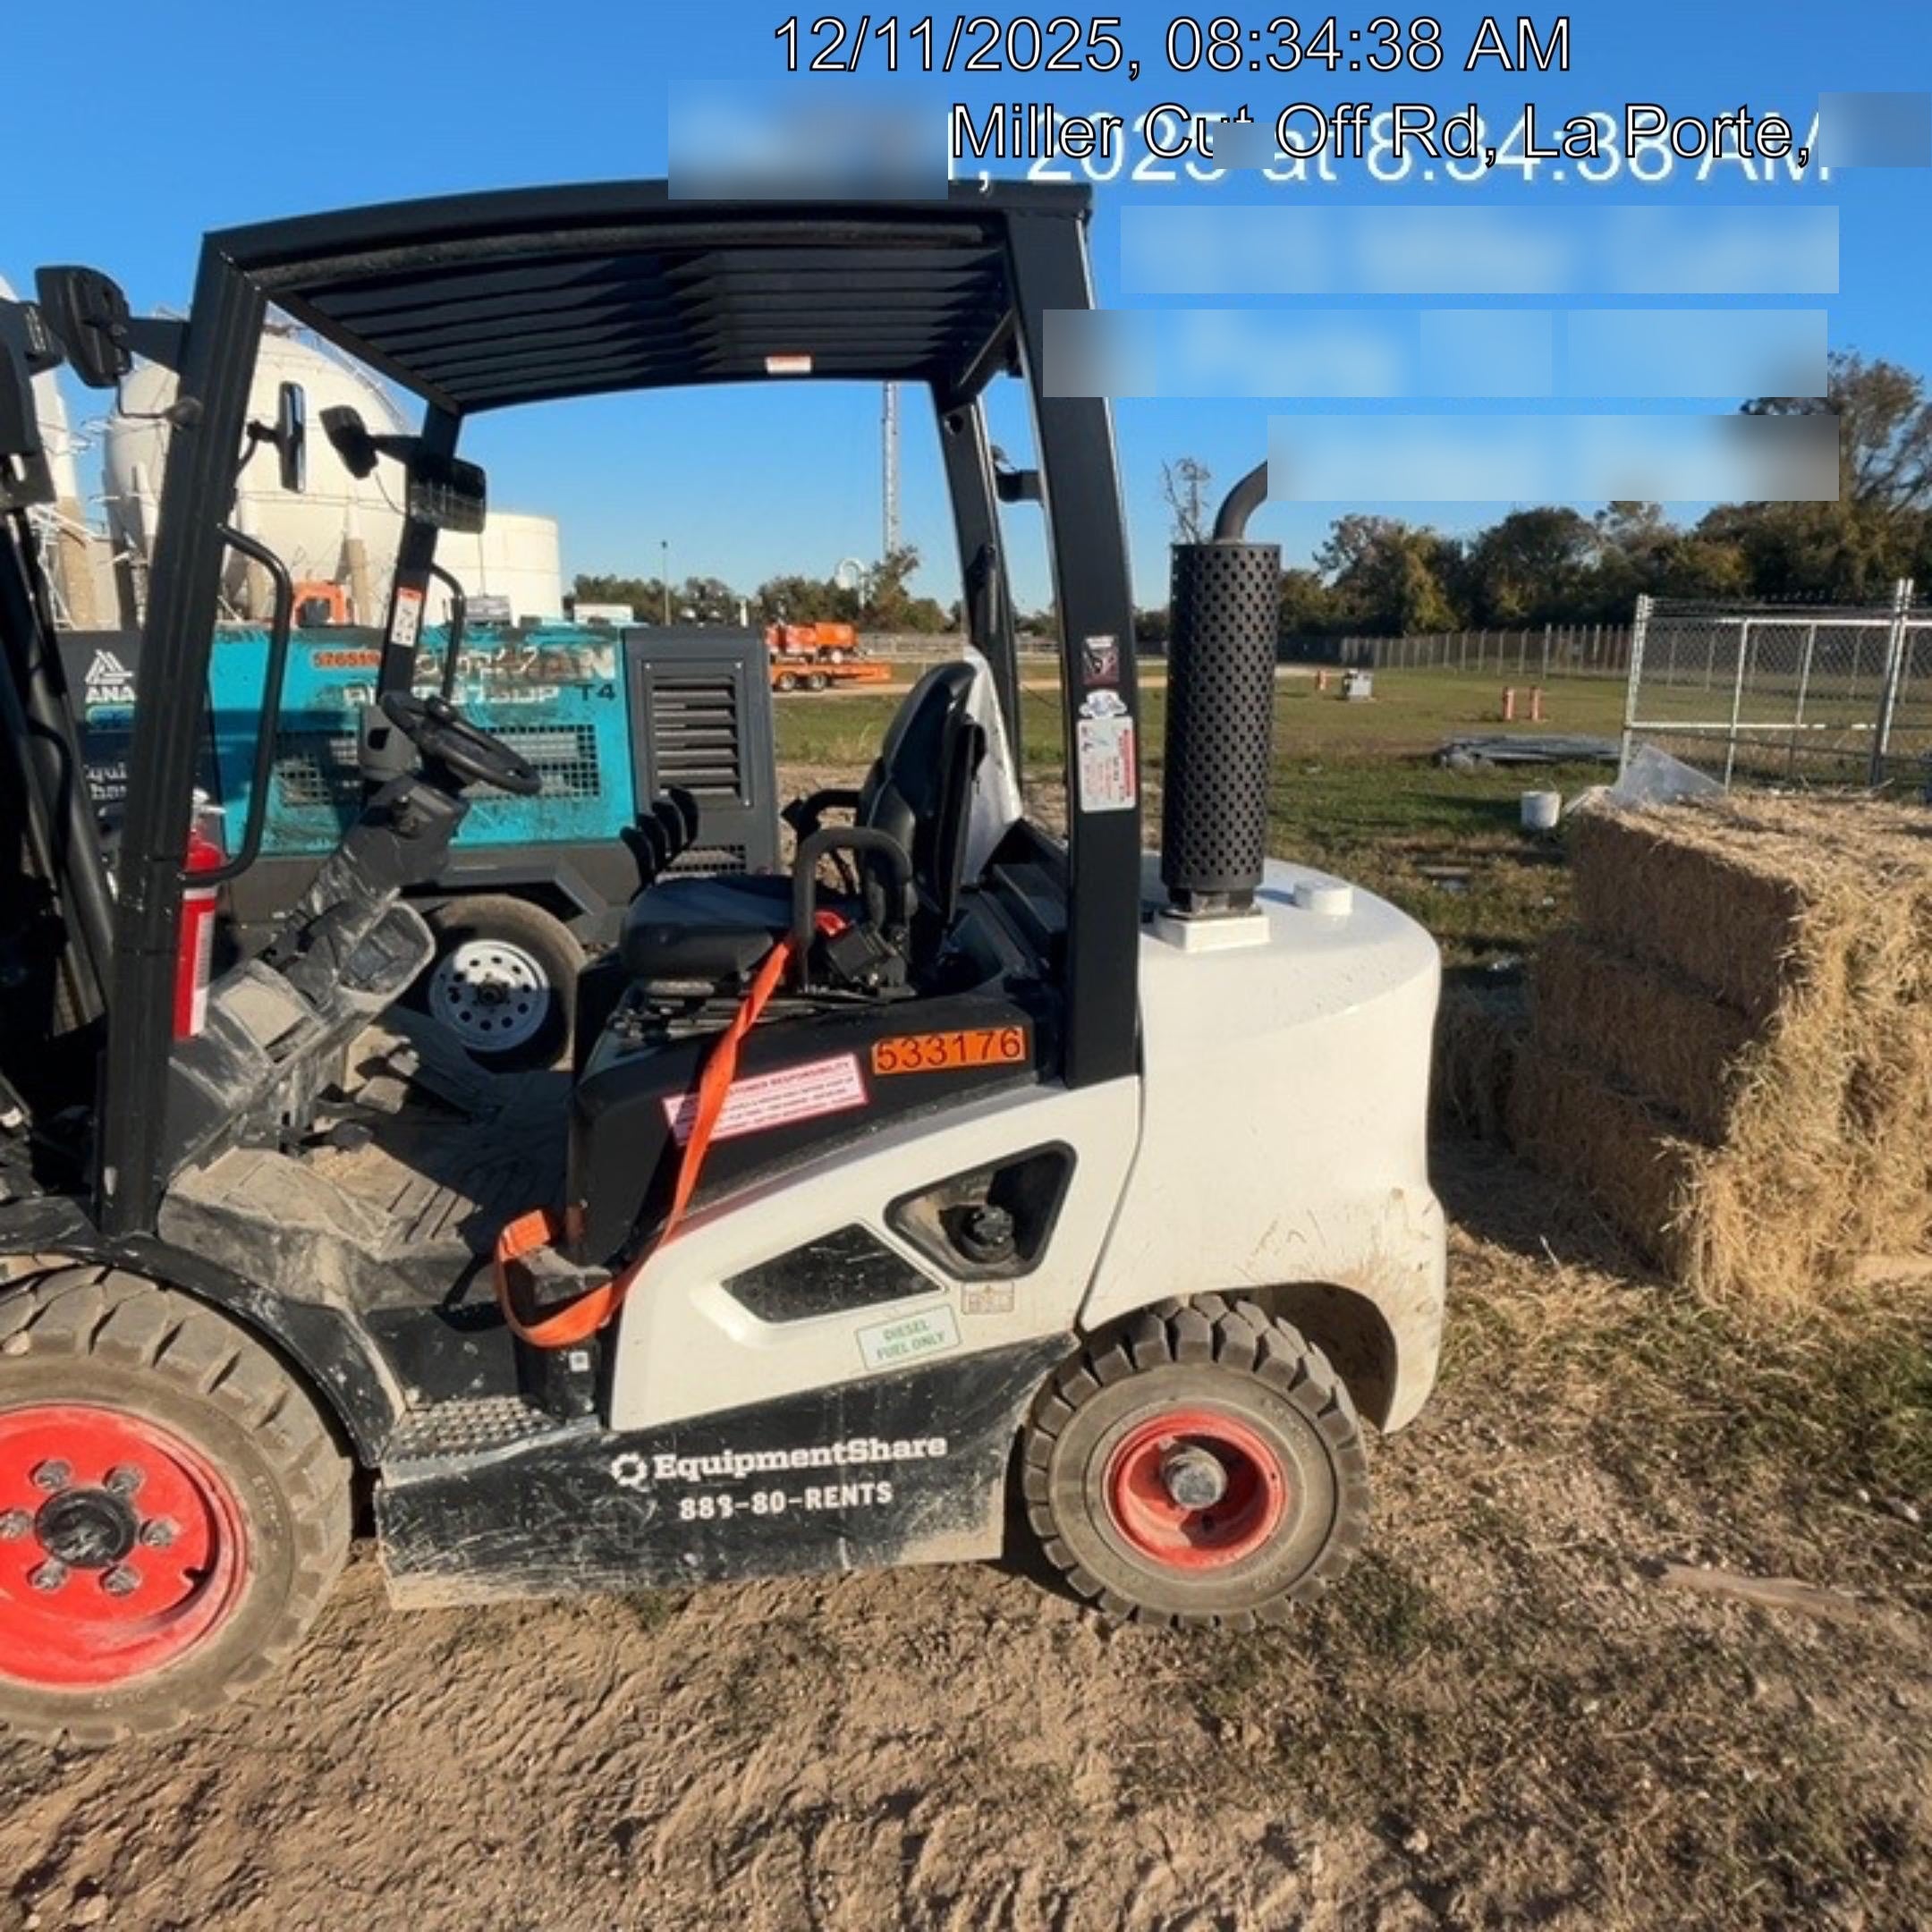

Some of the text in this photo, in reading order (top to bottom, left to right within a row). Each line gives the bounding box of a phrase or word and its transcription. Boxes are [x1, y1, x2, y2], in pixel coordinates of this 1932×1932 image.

[578, 683, 617, 702] T4
[876, 1029, 1022, 1072] 533176
[653, 1436, 949, 1481] EquipmentShare
